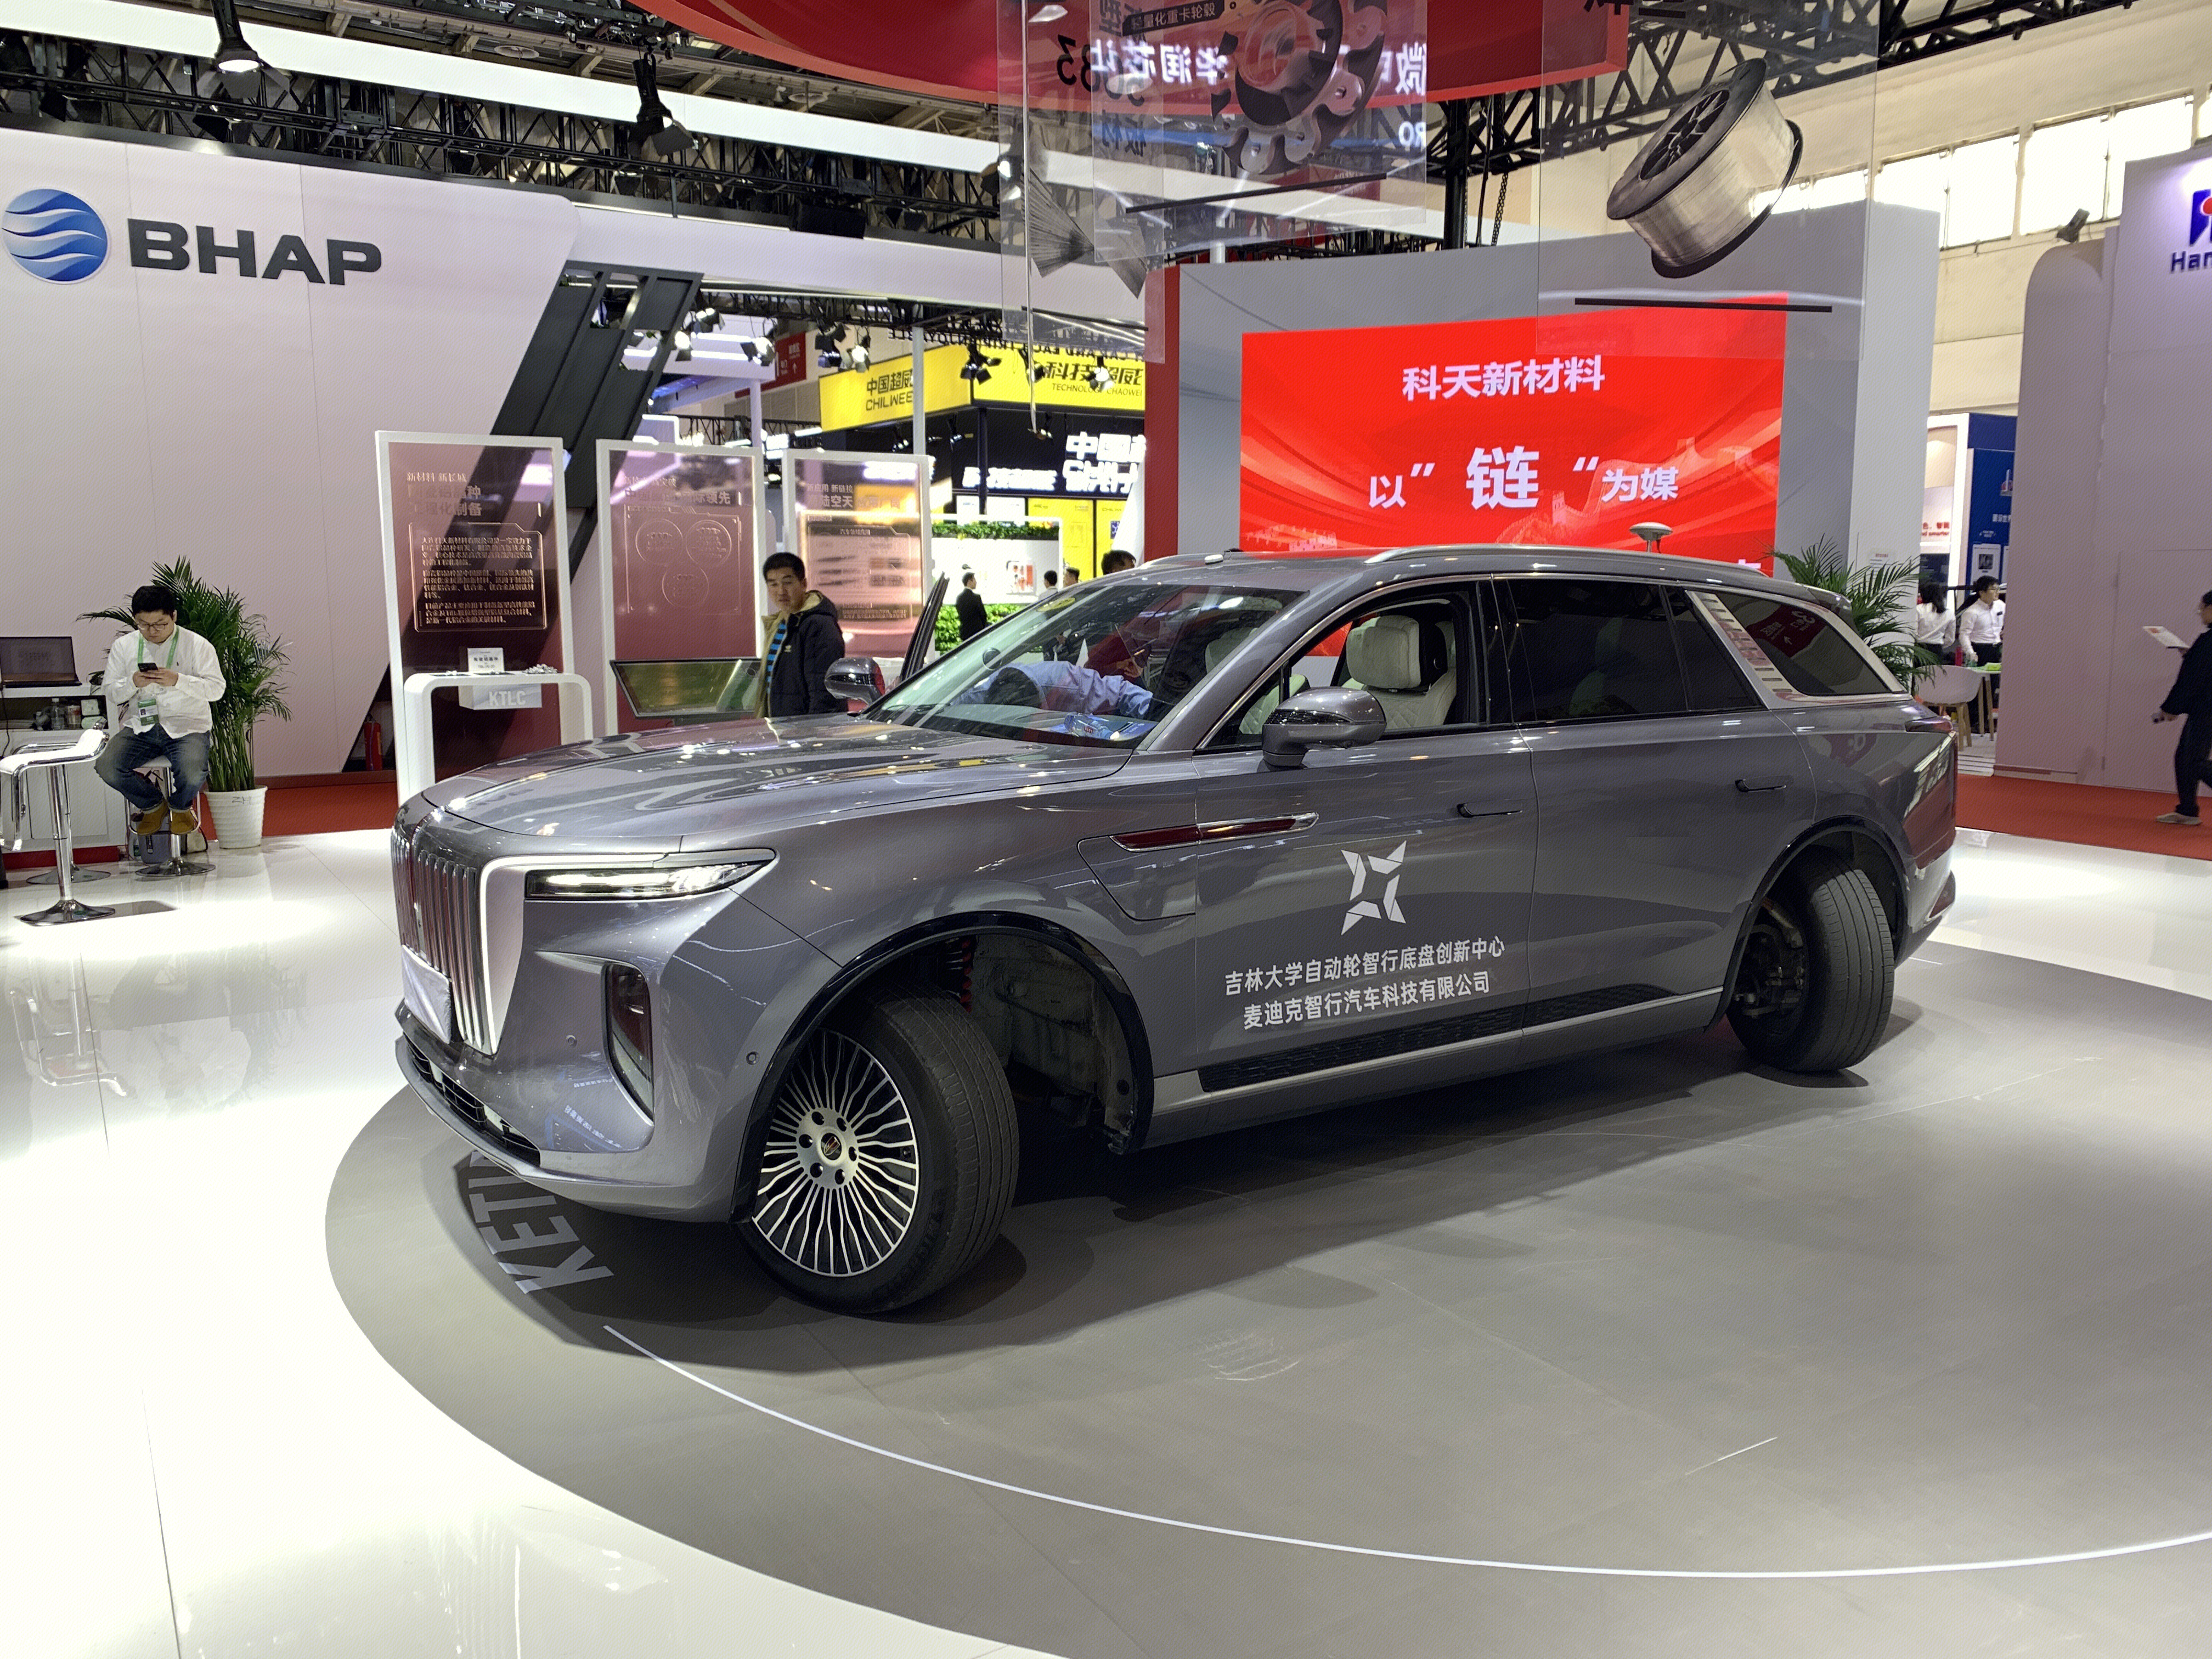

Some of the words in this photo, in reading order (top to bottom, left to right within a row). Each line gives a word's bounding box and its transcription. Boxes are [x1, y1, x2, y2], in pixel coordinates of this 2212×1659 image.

[127, 218, 382, 285] BHAP
[866, 390, 913, 411] CHILWEE
[1052, 382, 1102, 393] TECHNOLOG
[1107, 387, 1143, 397] CHAOWEI
[1402, 353, 1606, 402] 科天新材料
[407, 471, 435, 482] 新材料
[489, 690, 526, 707] KTLC
[1224, 935, 1505, 996] 吉林大学自动轮智行底盘创新中心
[1243, 971, 1490, 1030] 麦迪克智行汽车科技有限公司
[468, 1150, 614, 1294] KETI
